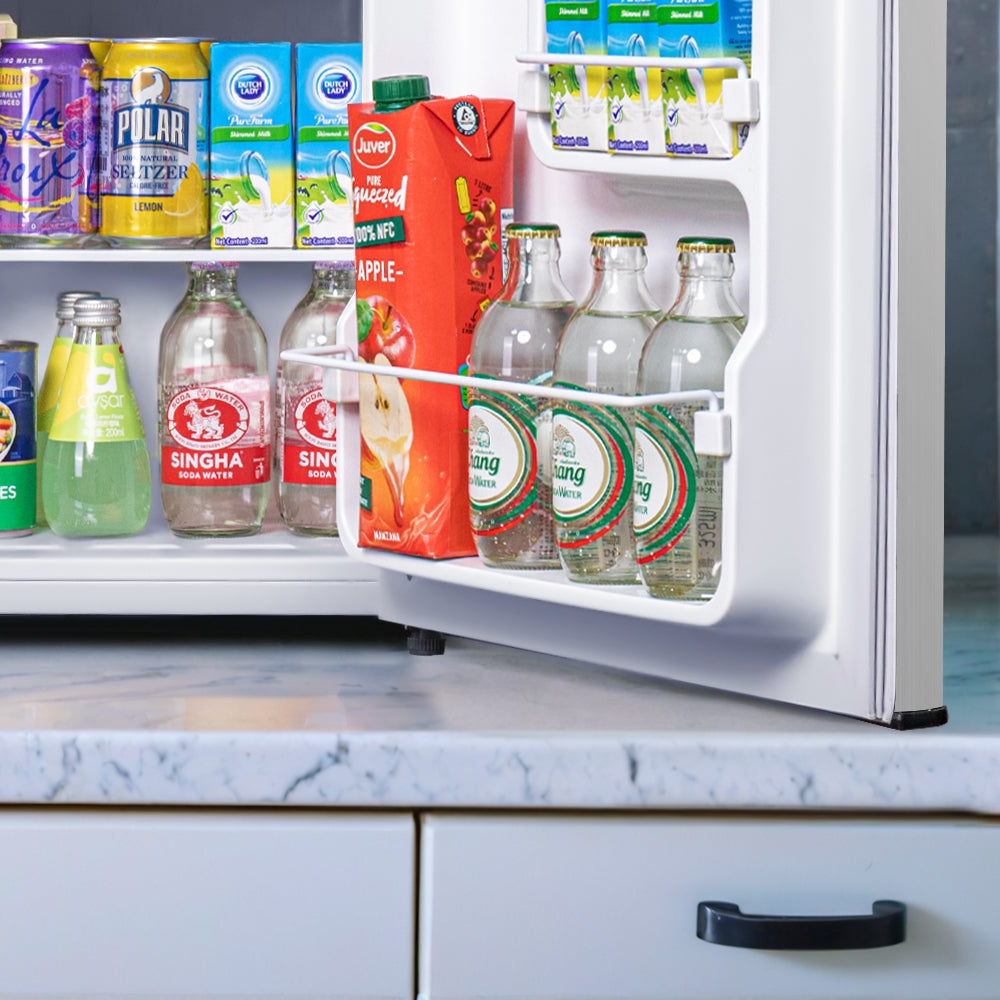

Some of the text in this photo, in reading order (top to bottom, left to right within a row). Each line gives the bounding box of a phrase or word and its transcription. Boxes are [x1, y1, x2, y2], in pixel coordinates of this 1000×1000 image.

[16, 57, 43, 65] WATER
[238, 81, 262, 89] DUTCH
[324, 81, 349, 89] DUTCH
[117, 107, 185, 146] POLAR
[357, 136, 391, 154] Juver
[366, 175, 382, 187] PURE
[353, 175, 408, 215] queezed
[134, 202, 163, 212] LEMON
[356, 221, 395, 243] 00% NFC
[171, 391, 244, 411] SODA WATER
[301, 392, 323, 408] SODA
[171, 451, 244, 469] SINGHA
[203, 471, 233, 479] WATER
[308, 470, 331, 478] SODA
